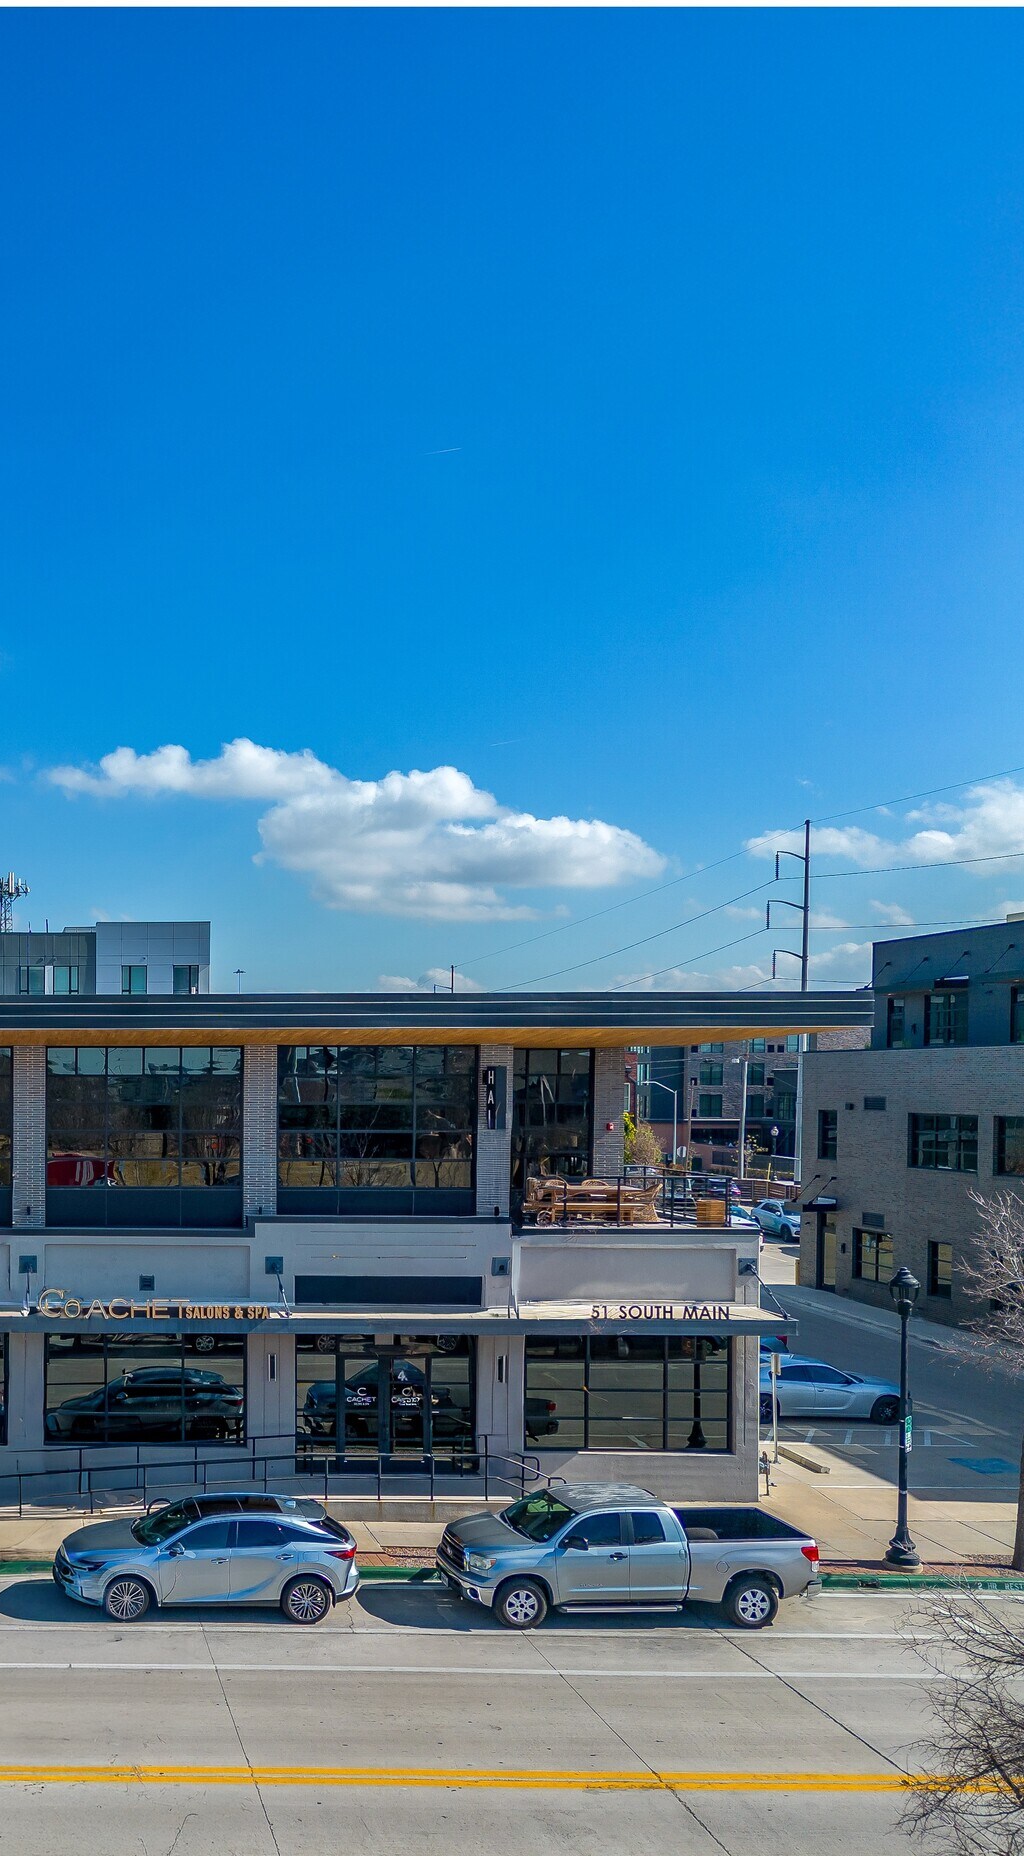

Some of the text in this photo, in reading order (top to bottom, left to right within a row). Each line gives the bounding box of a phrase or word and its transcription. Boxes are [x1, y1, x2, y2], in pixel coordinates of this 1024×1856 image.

[185, 1305, 270, 1319] SALONS & SPA
[591, 1305, 730, 1320] 51 SOUTH MAIN
[977, 1582, 983, 1590] 2
